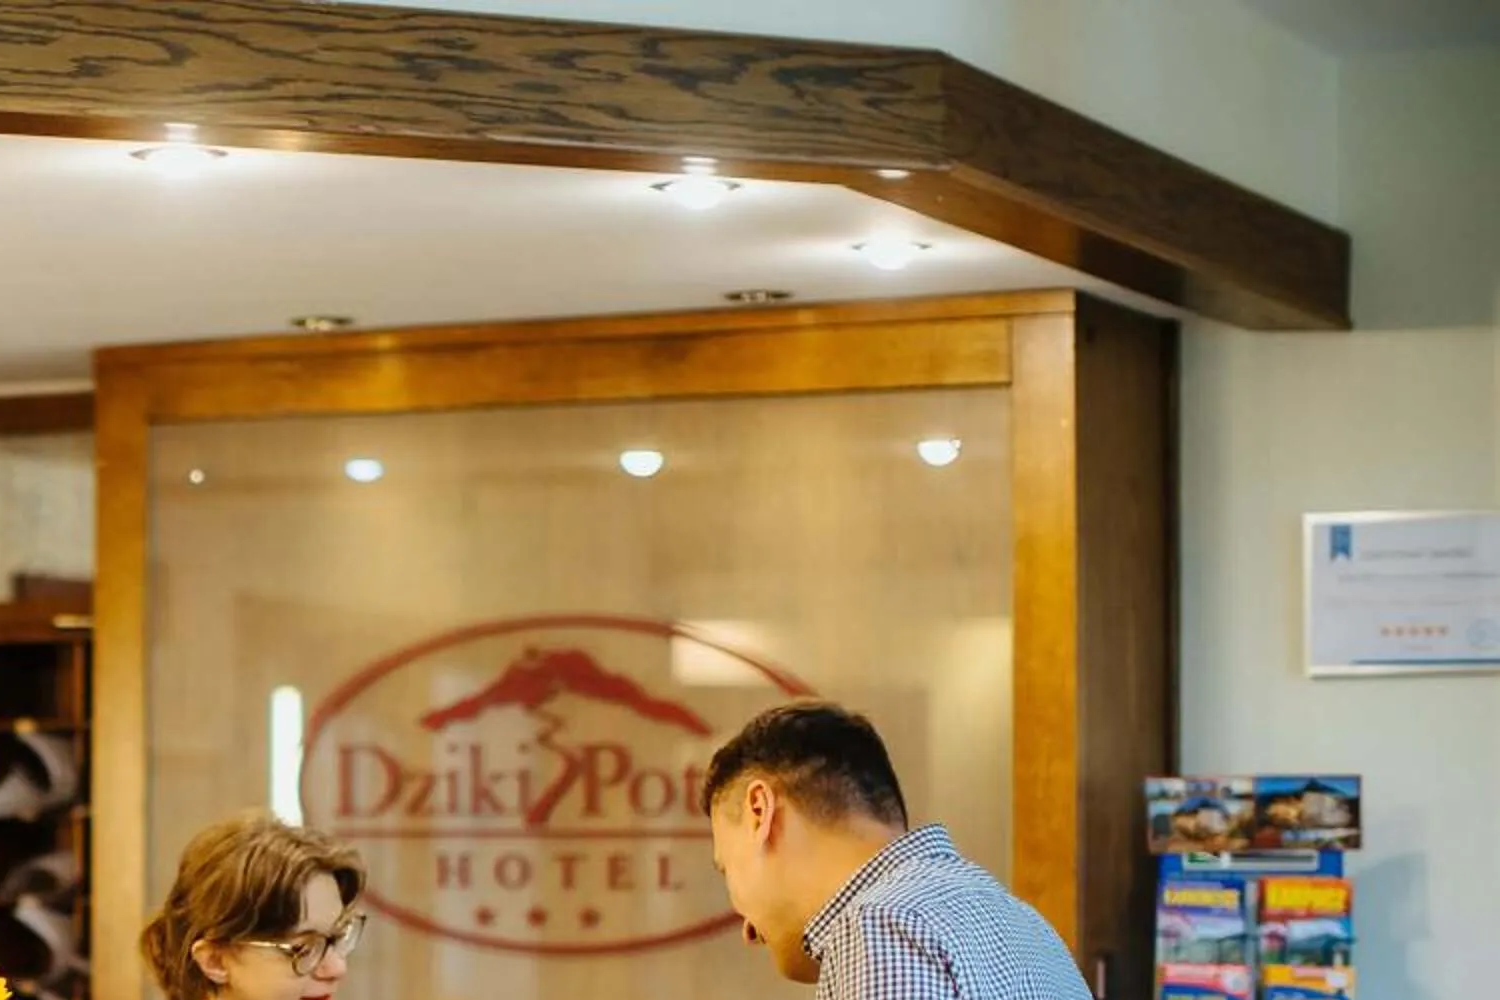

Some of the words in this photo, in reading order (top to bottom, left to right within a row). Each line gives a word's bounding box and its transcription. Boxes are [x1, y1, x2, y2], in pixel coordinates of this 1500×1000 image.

[336, 742, 535, 819] Dziki
[581, 744, 707, 818] Pot
[436, 854, 686, 891] HOTEL
